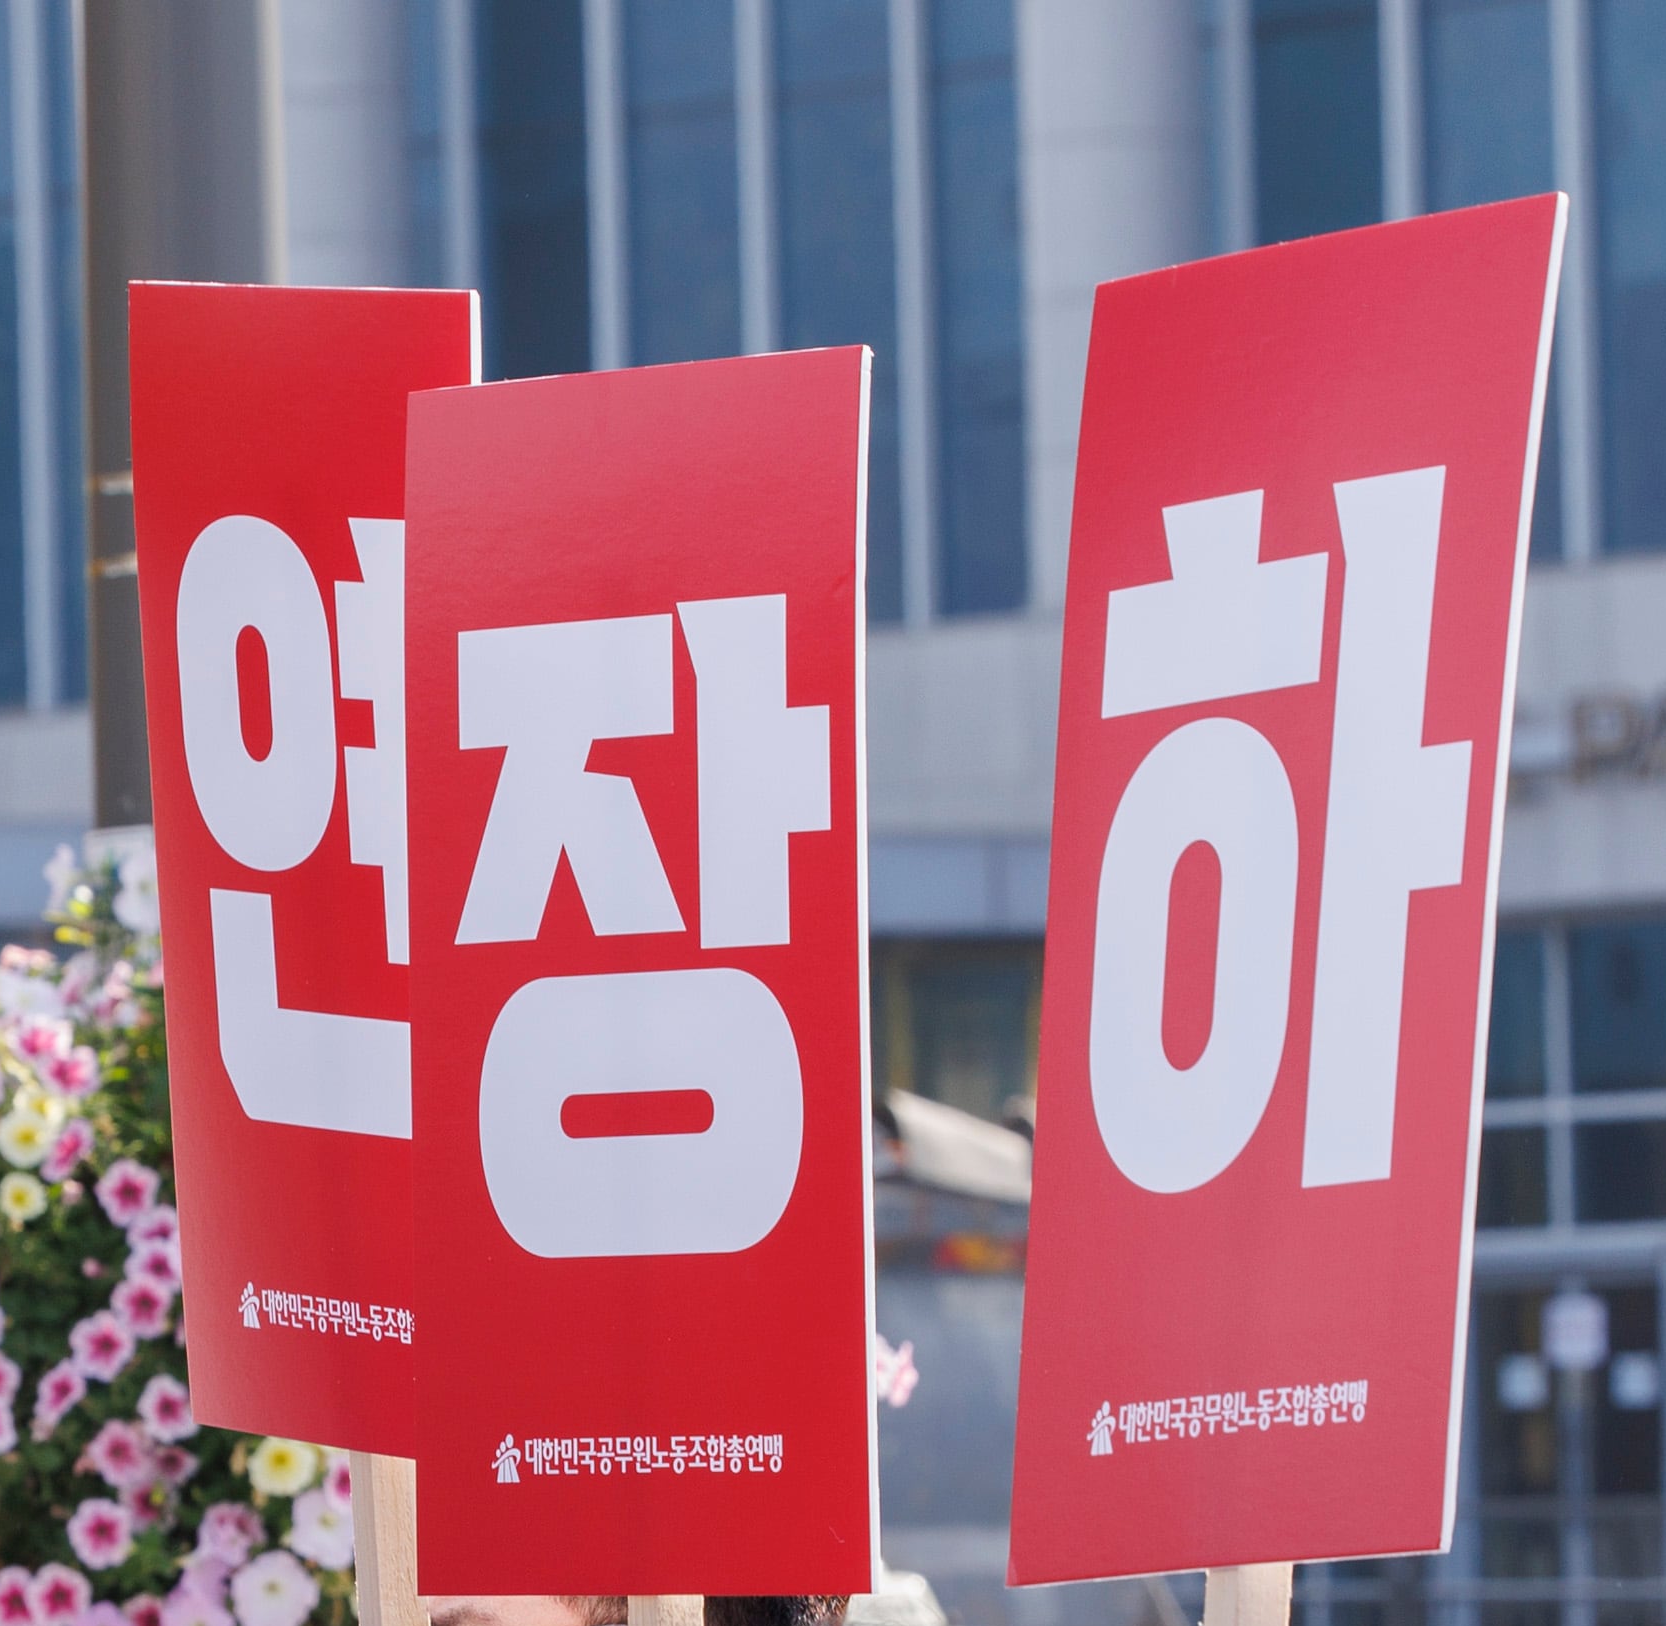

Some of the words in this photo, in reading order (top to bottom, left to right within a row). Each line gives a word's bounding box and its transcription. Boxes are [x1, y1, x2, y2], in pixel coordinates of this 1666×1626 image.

[176, 514, 413, 1139] 연
[455, 593, 831, 1258] 장
[1090, 465, 1472, 1192] 하
[262, 1290, 414, 1344] 대한민국공무원노동조합
[525, 1435, 783, 1475] 대한민국공무원노동조합총연맹
[1119, 1380, 1368, 1443] 대한민국공무원노동조합총연맹
